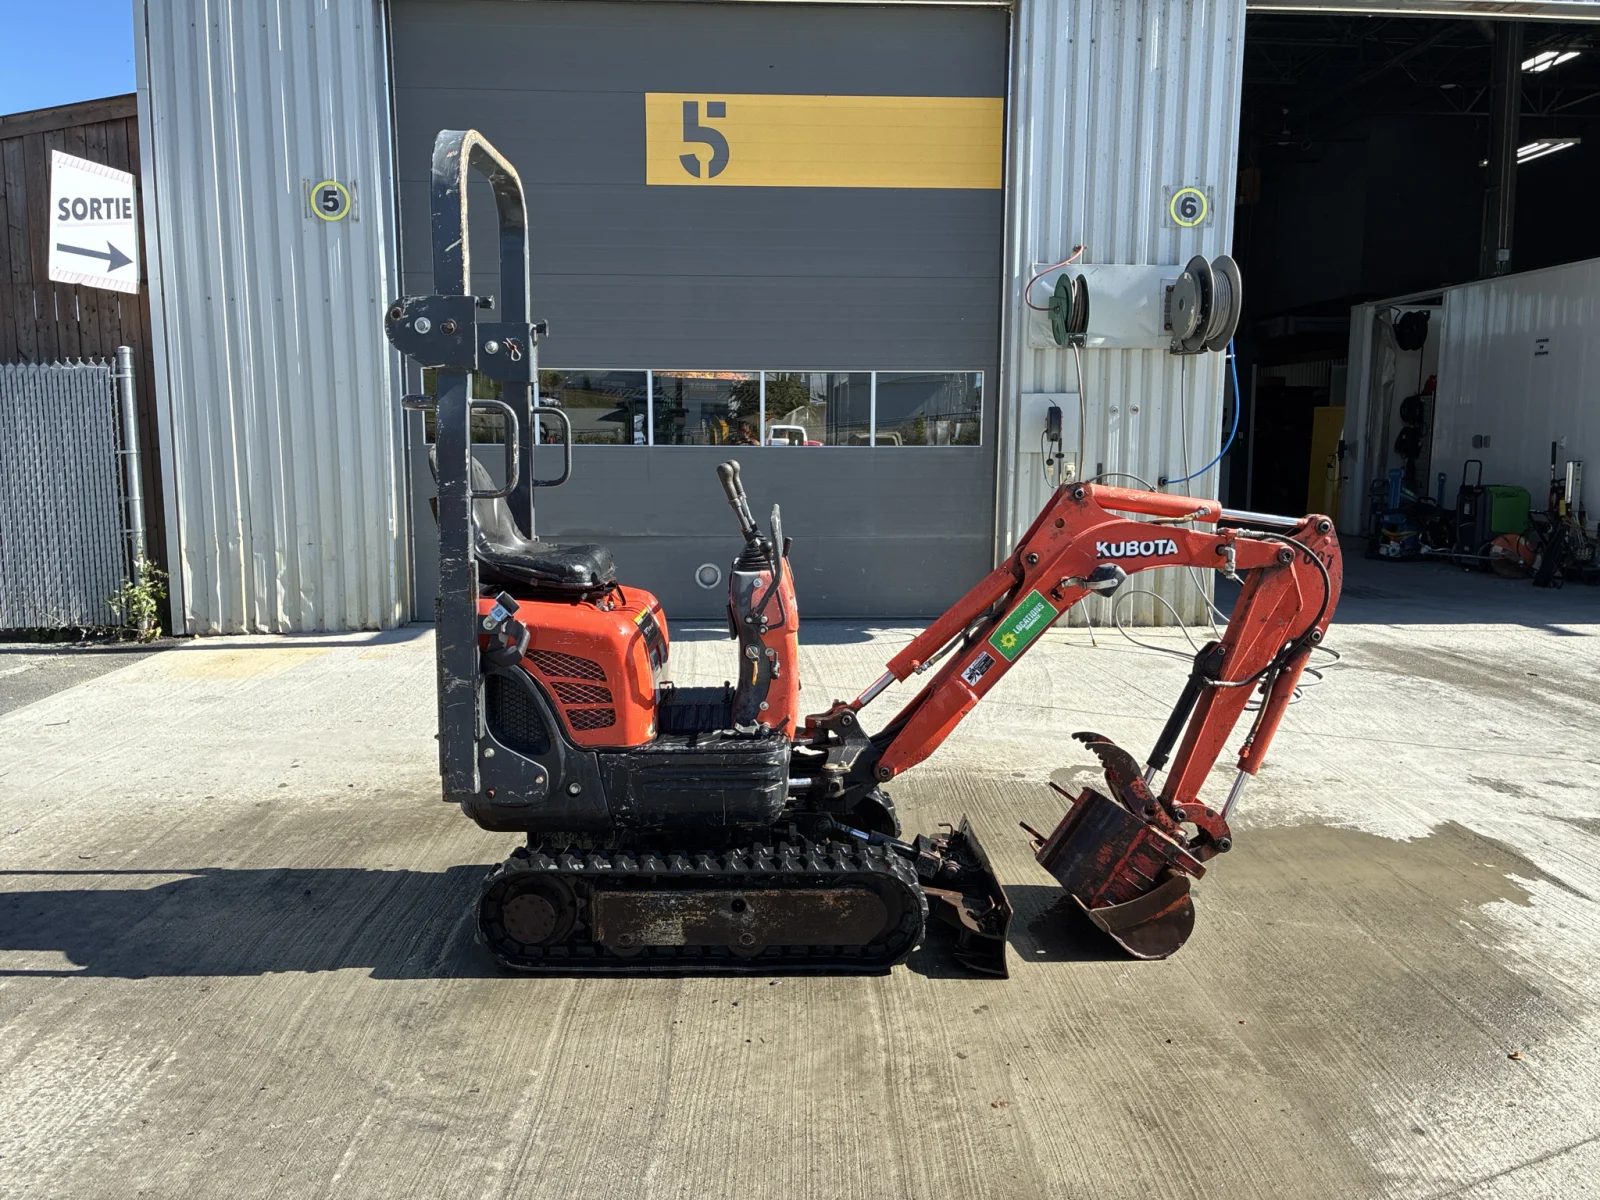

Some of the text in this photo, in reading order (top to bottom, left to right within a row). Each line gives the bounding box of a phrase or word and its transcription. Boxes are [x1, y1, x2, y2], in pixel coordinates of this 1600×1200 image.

[679, 101, 729, 178] 5
[57, 197, 133, 222] SORTIE
[323, 190, 340, 212] 5
[1180, 196, 1197, 218] 6
[1095, 539, 1179, 558] KUBOTA
[1012, 602, 1045, 634] LOCATIONS
